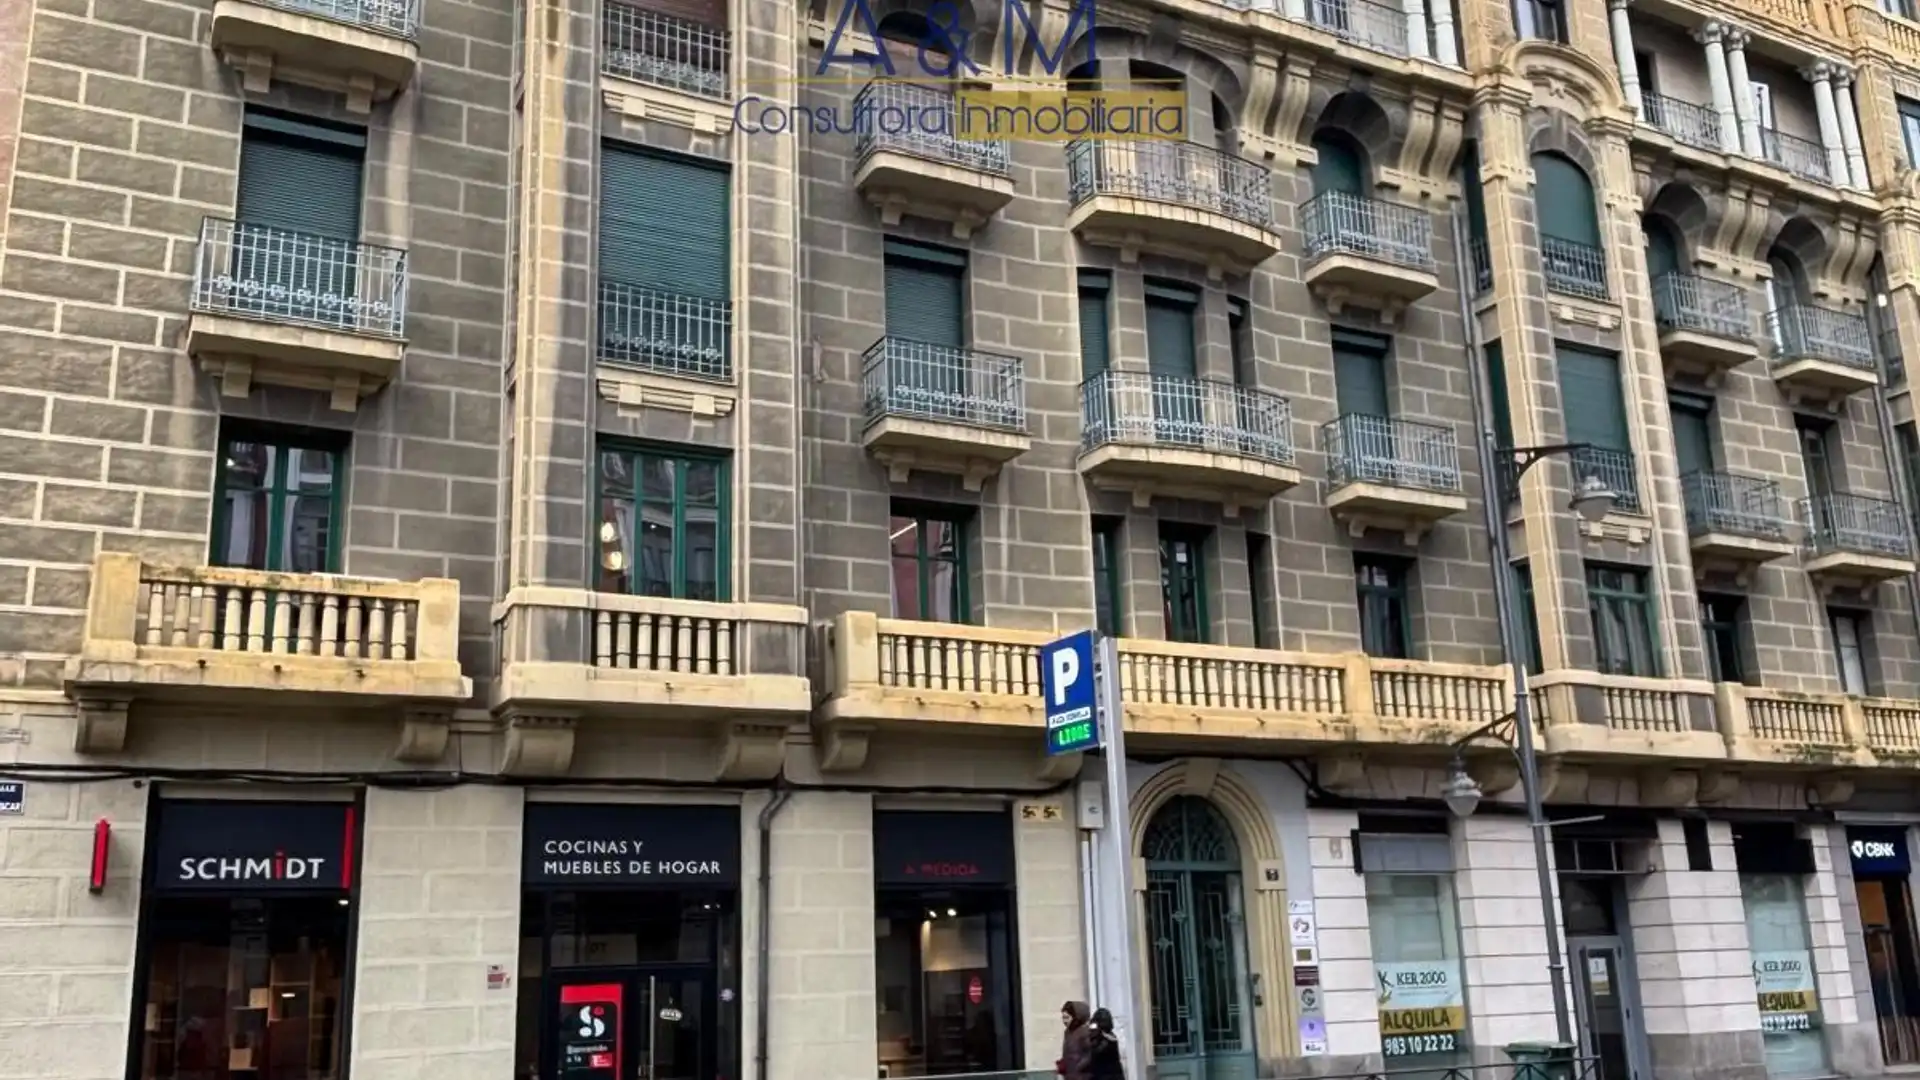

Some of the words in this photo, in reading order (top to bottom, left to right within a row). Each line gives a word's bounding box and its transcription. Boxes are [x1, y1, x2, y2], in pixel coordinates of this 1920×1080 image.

[1052, 647, 1079, 706] P
[544, 840, 628, 855] COCINAS
[632, 840, 644, 855] Y
[1865, 842, 1896, 858] CBNK
[543, 860, 622, 875] MUEBLES
[628, 860, 652, 875] DE
[658, 860, 721, 875] HOGAR
[1396, 971, 1418, 986] KER
[1383, 1008, 1451, 1031] ALQUILA
[1385, 1036, 1406, 1056] 983
[1408, 1035, 1422, 1054] 10
[1424, 1034, 1438, 1052] 22
[1440, 1033, 1455, 1051] 22
